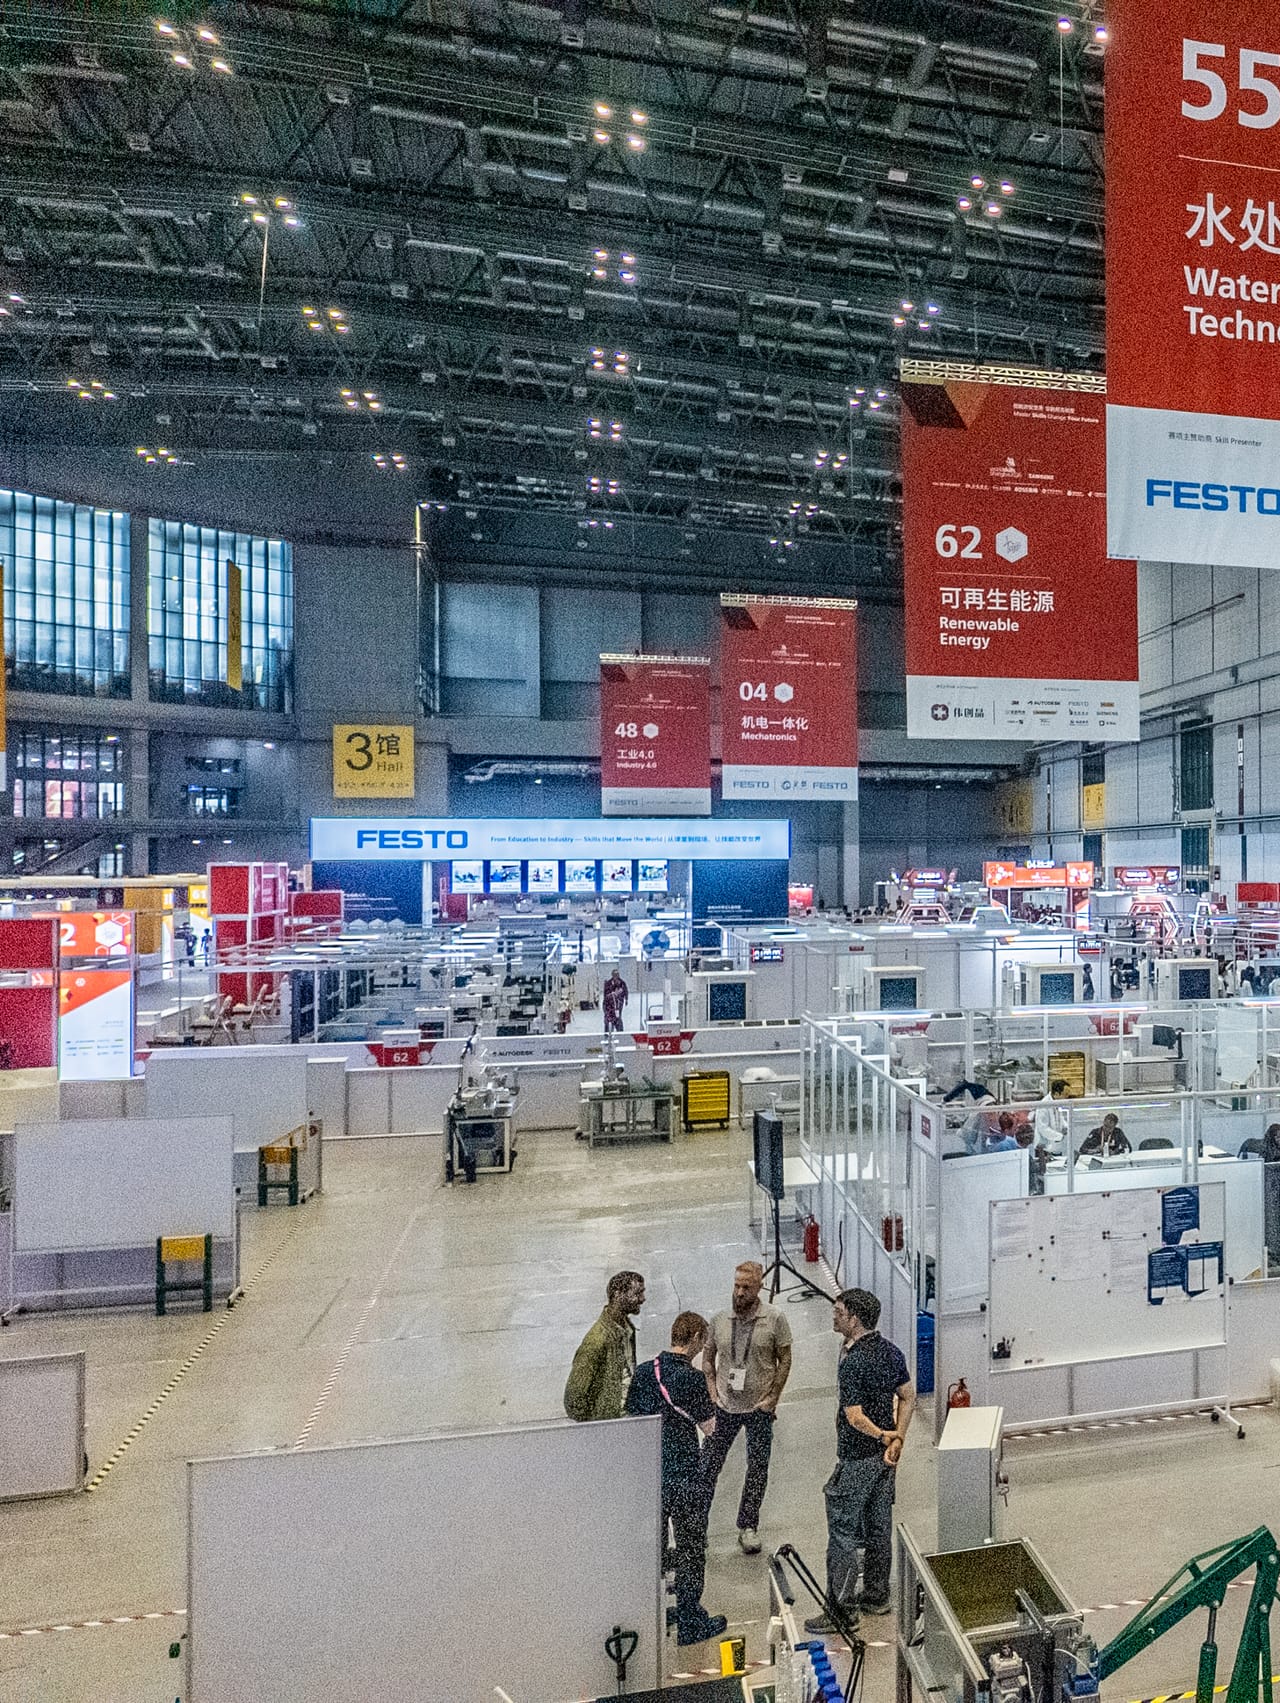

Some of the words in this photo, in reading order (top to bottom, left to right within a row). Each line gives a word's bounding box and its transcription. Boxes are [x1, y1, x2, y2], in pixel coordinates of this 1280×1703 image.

[1215, 436, 1229, 444] Skill
[1231, 437, 1262, 447] Presenter
[935, 524, 983, 560] 62
[939, 586, 1055, 613] 可再生能源
[939, 616, 1020, 633] Renewable
[940, 632, 990, 650] Energy
[739, 681, 768, 702] 04
[614, 722, 638, 738] 48
[741, 716, 809, 731] 机电一体化
[741, 731, 797, 742] Mechatronics
[346, 732, 374, 771] 3
[375, 733, 401, 756] 馆
[616, 749, 655, 760] 工业4.0
[376, 761, 403, 772] Hall
[616, 761, 645, 770] Industry
[733, 781, 770, 789] FESTO
[813, 782, 848, 790] FESTO
[356, 830, 468, 849] FESTO
[656, 1041, 672, 1052] 62
[393, 1052, 409, 1063] 62
